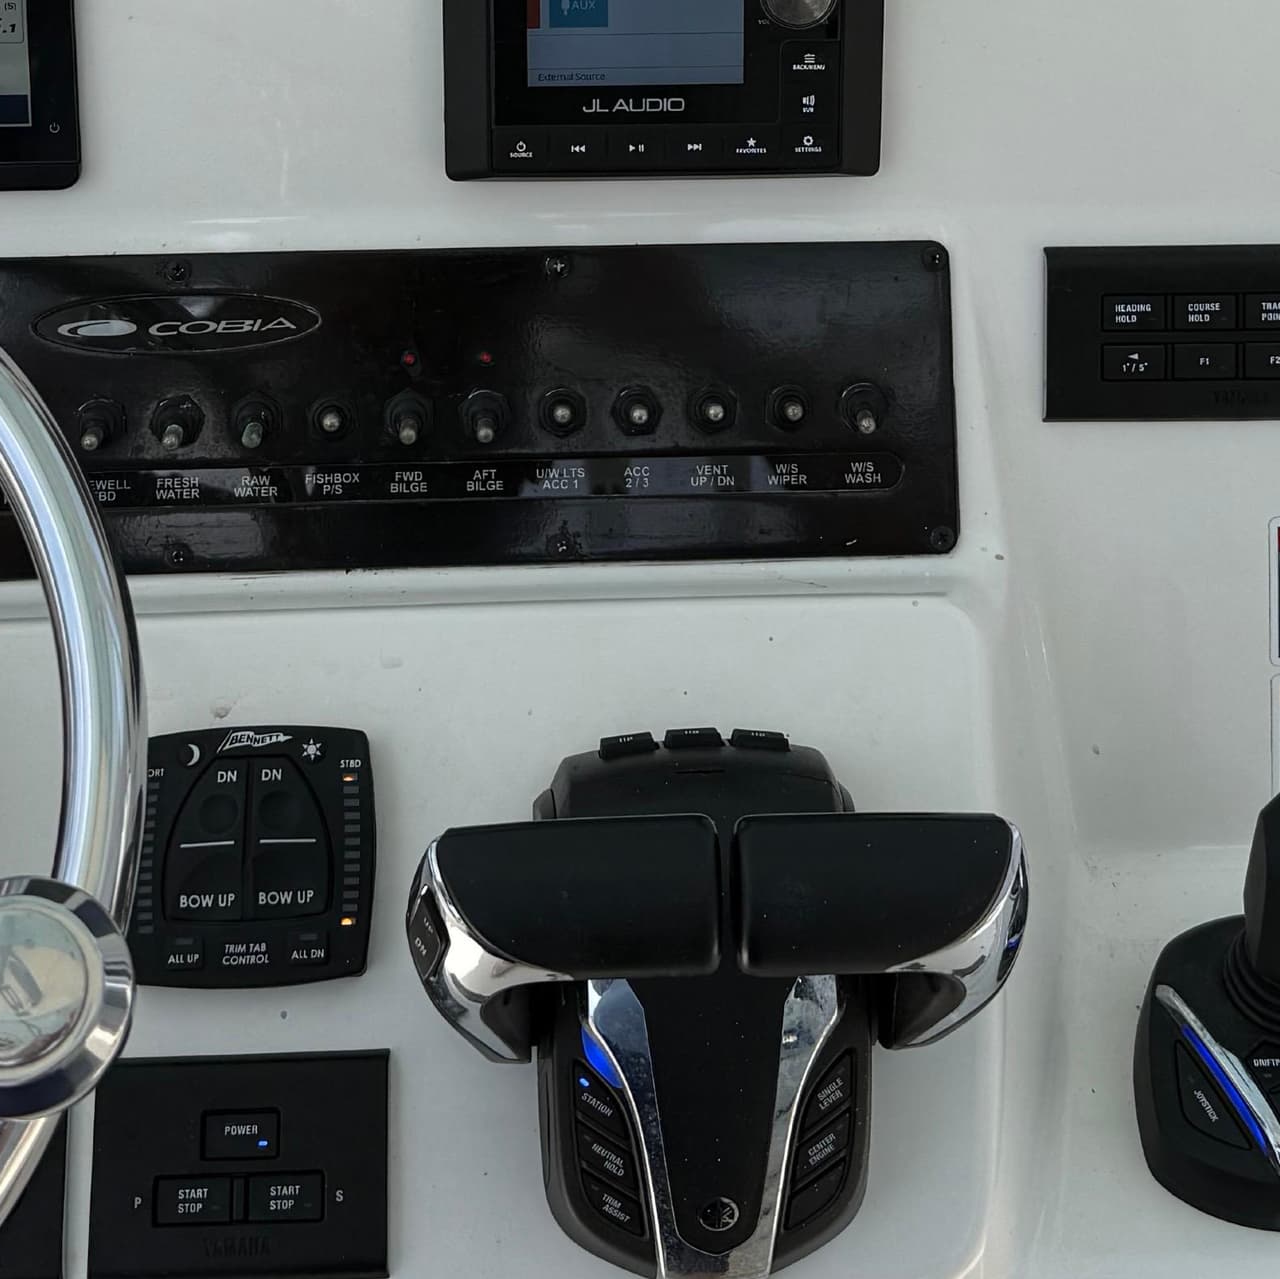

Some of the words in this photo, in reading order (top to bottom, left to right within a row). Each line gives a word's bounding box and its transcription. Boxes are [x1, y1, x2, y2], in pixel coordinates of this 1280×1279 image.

[572, 0, 595, 10] AUX
[582, 98, 608, 112] JL
[613, 98, 685, 112] AUDIO
[1188, 302, 1221, 312] COURSE
[148, 318, 296, 336] COBIA
[1200, 357, 1209, 365] F1
[1270, 356, 1280, 365] F2
[536, 467, 559, 479] U/W
[563, 467, 585, 478] LTS
[624, 466, 650, 477] ACC
[696, 464, 729, 476] VENT
[776, 463, 799, 475] W/S
[851, 462, 874, 473] W/S
[305, 473, 360, 485] FISHBOX
[395, 472, 423, 482] FWD
[473, 469, 496, 481] AFT
[768, 474, 807, 485] WIPER
[845, 472, 881, 484] WASH
[156, 477, 199, 488] FRESH
[241, 475, 270, 487] RAW
[466, 480, 504, 492] BILGE
[542, 479, 568, 490] ACC
[573, 479, 578, 490] 1
[234, 485, 278, 498] WATER
[323, 483, 342, 495] P/S
[390, 482, 427, 493] BILGE
[155, 488, 199, 500] WATER
[229, 731, 283, 746] BENNETT
[340, 759, 361, 768] STBD
[217, 771, 237, 783] DN
[262, 769, 282, 781] DN
[180, 895, 214, 908] BOW
[218, 894, 235, 906] UP
[259, 892, 293, 905] BOW
[297, 890, 314, 903] UP
[225, 944, 247, 954] TRIM
[249, 943, 266, 952] TAB
[168, 955, 184, 964] ALL
[187, 954, 199, 963] UP
[223, 954, 269, 965] CONTROL
[292, 950, 308, 960] ALL
[311, 949, 324, 959] DN
[224, 1125, 258, 1136] POWER
[178, 1188, 208, 1200] START
[270, 1185, 300, 1196] START
[336, 1190, 344, 1202] S
[134, 1197, 142, 1208] P
[270, 1200, 294, 1210] STOP
[178, 1203, 202, 1214] STOP
